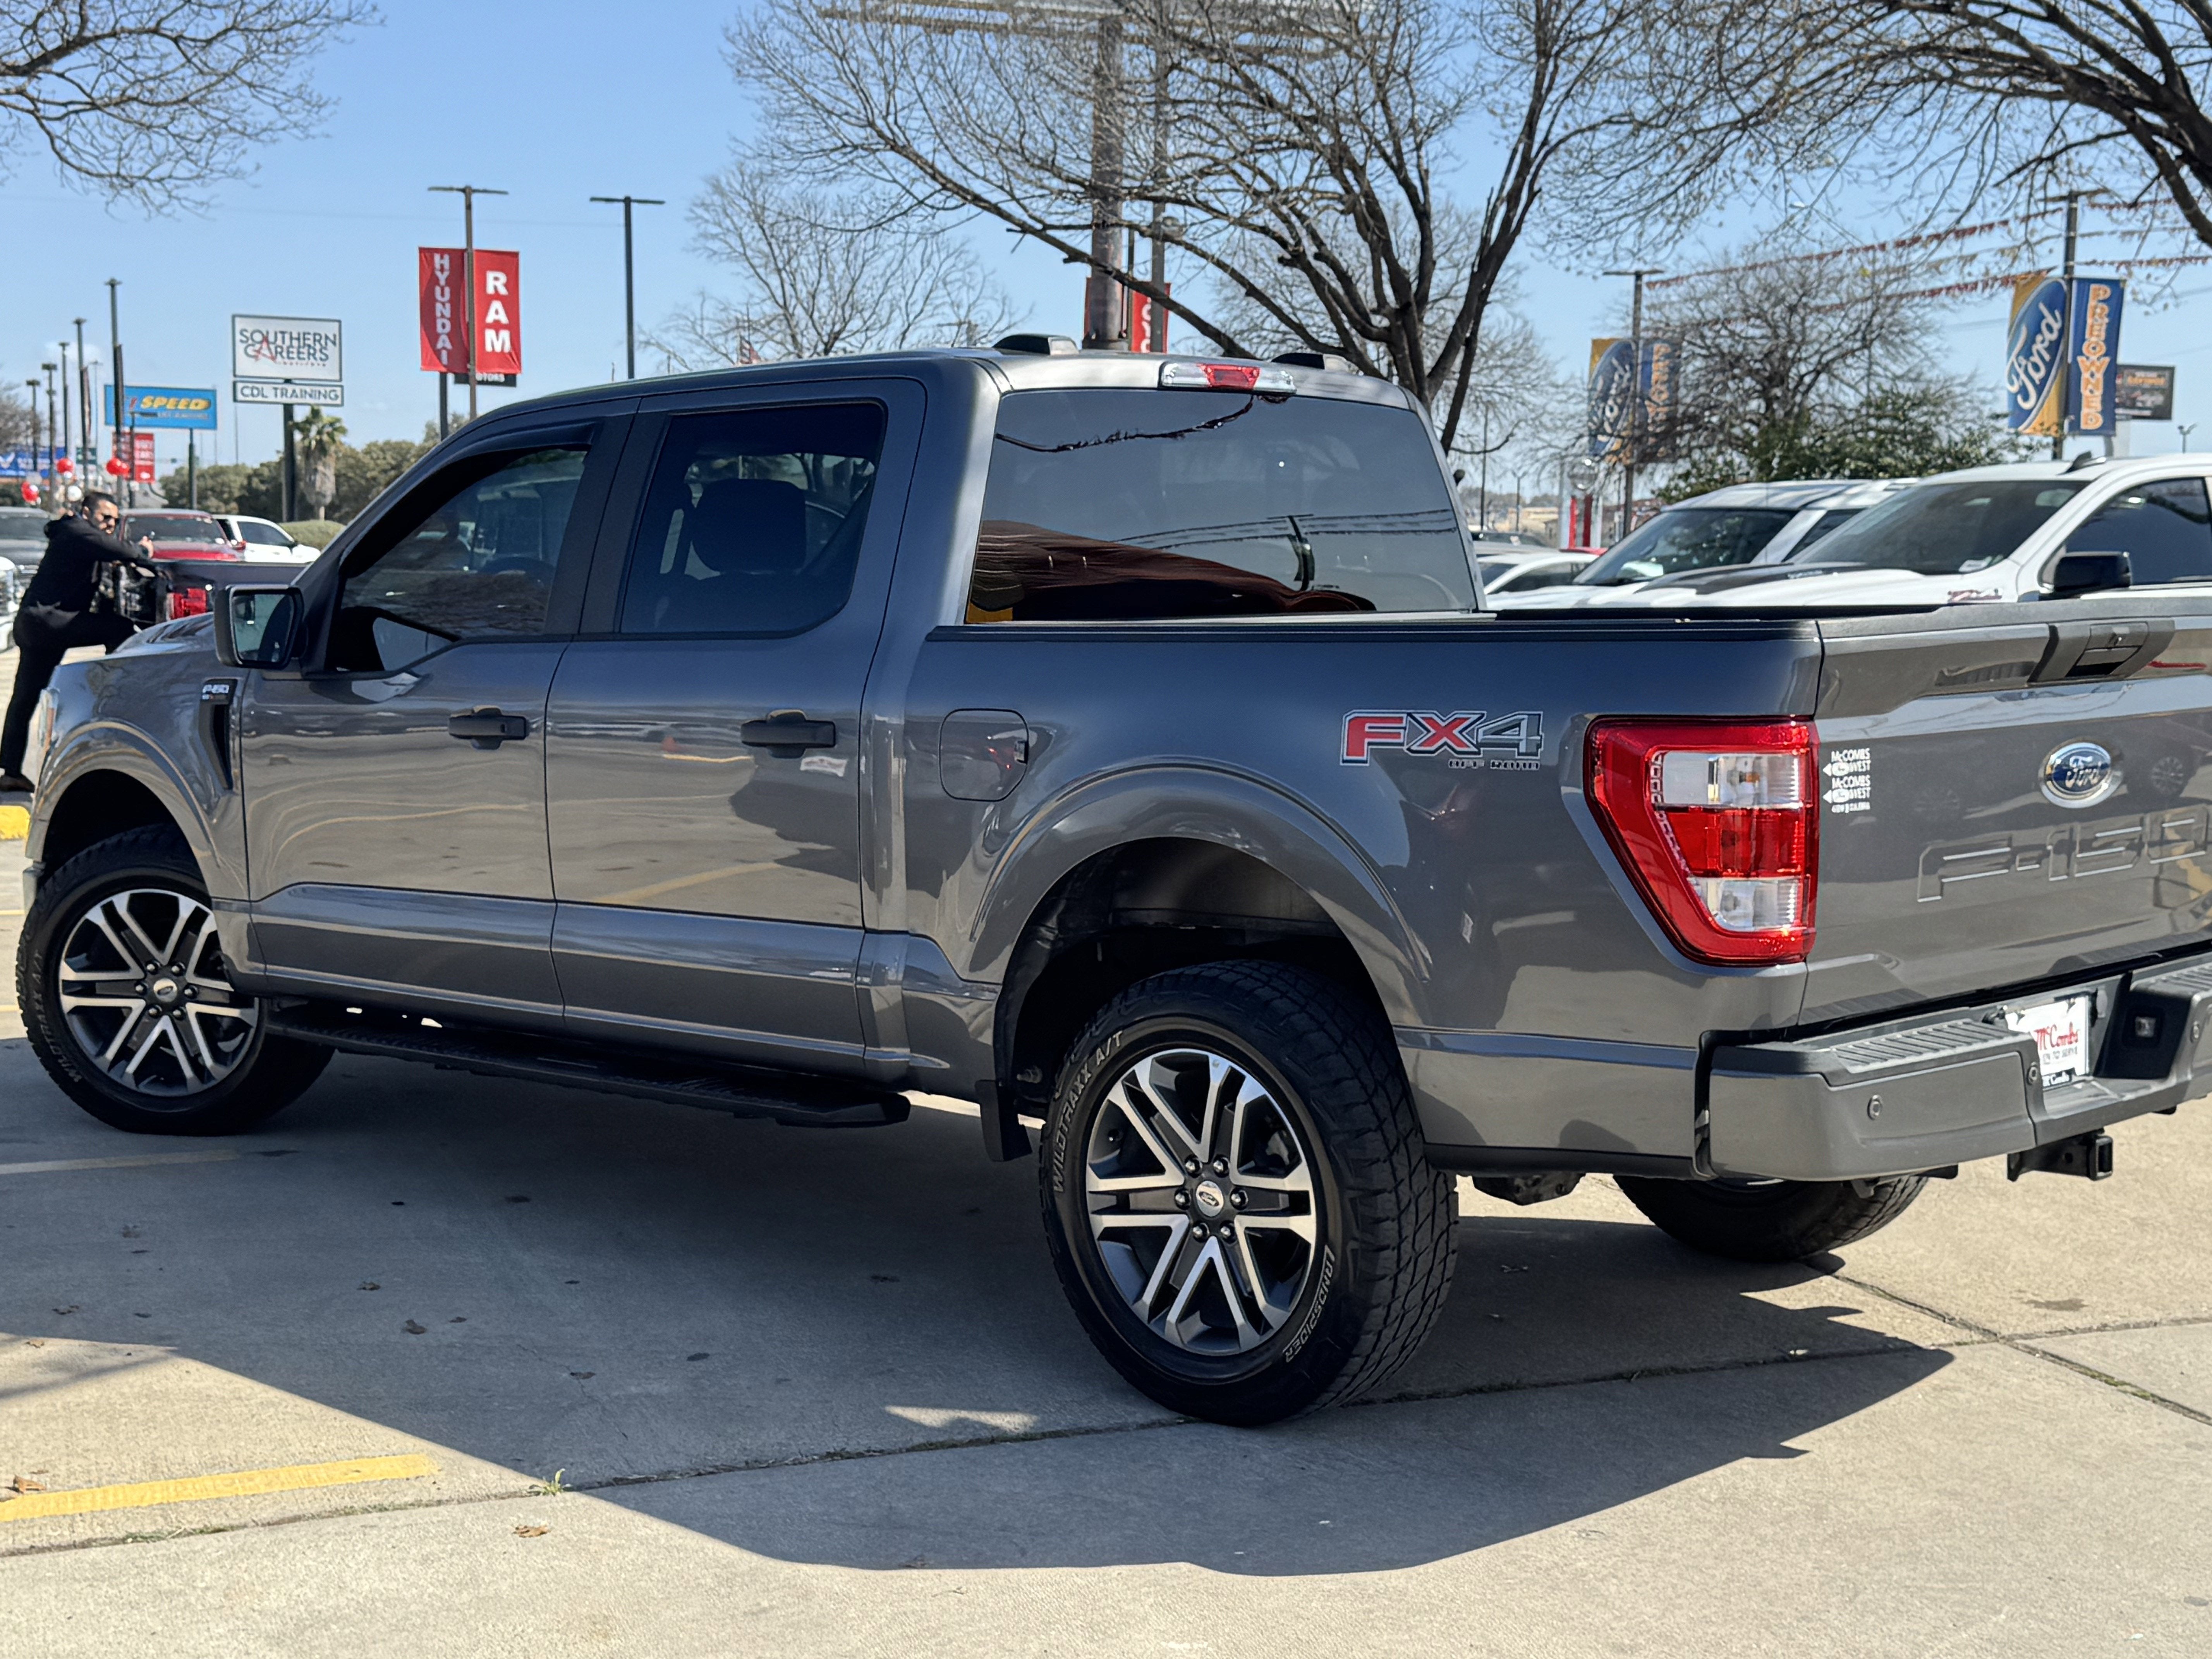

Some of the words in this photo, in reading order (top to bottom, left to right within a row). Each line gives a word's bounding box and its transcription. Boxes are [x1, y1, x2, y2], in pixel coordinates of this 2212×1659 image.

[434, 253, 452, 366] HYUNDAI
[485, 270, 510, 353] RAM
[239, 328, 337, 347] SOUTHERN
[244, 341, 329, 362] CAREERS
[2005, 301, 2062, 410] Ford
[140, 395, 211, 410] SPEED
[240, 386, 268, 398] CDL
[272, 386, 340, 401] TRAINING
[1340, 709, 1545, 766] FX4
[2065, 756, 2102, 788] Ford
[1053, 1062, 1091, 1192] WILDTRAXX
[1095, 1030, 1123, 1066] A/T
